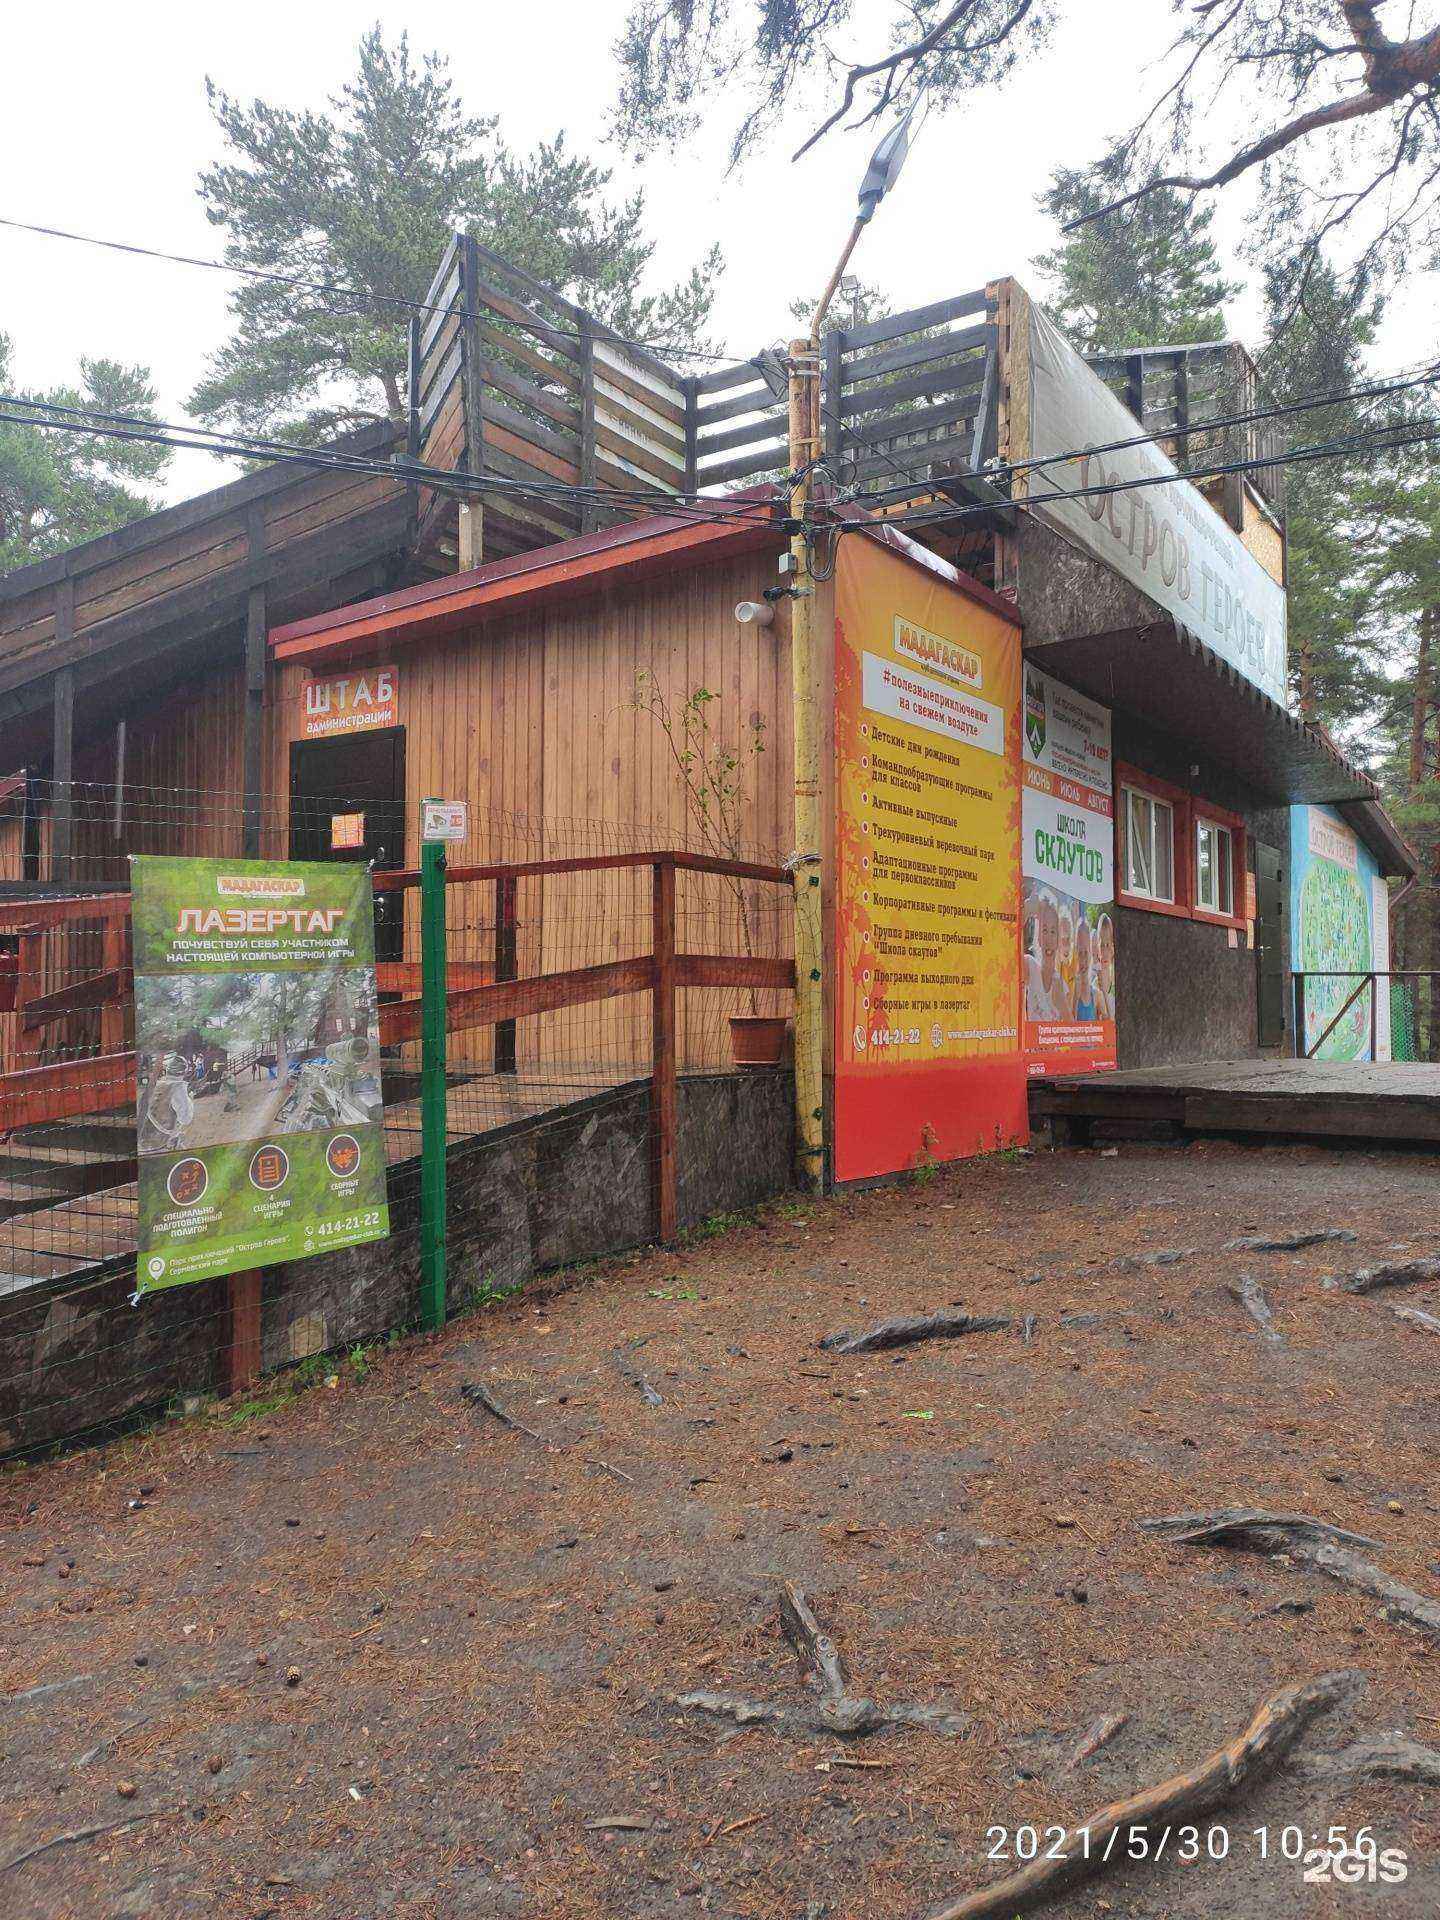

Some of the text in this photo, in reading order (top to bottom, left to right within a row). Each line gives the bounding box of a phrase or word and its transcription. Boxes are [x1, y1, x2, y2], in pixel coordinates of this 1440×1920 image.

[1080, 442, 1191, 600] ОСТРОВ
[899, 623, 979, 680] МАДАГАСКАР
[306, 672, 393, 715] ШТАБ
[306, 710, 392, 734] администрации
[899, 697, 979, 737] на свежем воздухе
[871, 726, 960, 767] Детские дни рождения
[871, 754, 994, 802] Командообразующие программы
[871, 771, 922, 793] для классов
[1027, 768, 1051, 790] ИЮНЬ
[872, 796, 958, 829] Активные выпускные
[1057, 813, 1087, 840] ШКОЛА
[872, 823, 935, 850] Трехуровневый
[979, 847, 996, 862] парк
[872, 851, 979, 882] Адаптационные программы
[1034, 828, 1103, 884] СКАУТОВ
[872, 867, 957, 891] для первоклассников
[872, 891, 936, 914] Корпоративные
[937, 903, 978, 918] программы
[176, 908, 344, 934] ЛАЗЕРТАГ
[873, 923, 903, 943] Группа
[904, 928, 941, 943] дневного
[172, 938, 349, 950] ПОЧУВСТВУЙ СЕБЯ УЧАСТНИКОМ
[166, 949, 355, 964] НАСТОЯЩЕЙ КОМПЬЮТЕРНОЙ ИГРЫ
[873, 969, 919, 985] Программа
[920, 971, 960, 986] выходного
[872, 998, 910, 1011] Сборные
[911, 1000, 931, 1012] игры
[939, 999, 972, 1011] лазертаг
[870, 1027, 920, 1045] 414-21-22
[330, 1178, 360, 1191] СБОРНЫЕ
[337, 1187, 356, 1198] ИГРЫ
[162, 1206, 215, 1222] СПЕЦИАЛЬНО
[252, 1199, 292, 1214] СЦЕНАРИЯ
[263, 1209, 285, 1220] ИГРЫ
[170, 1224, 209, 1239] ПОЛИГОН
[317, 1211, 380, 1237] 414-21-22
